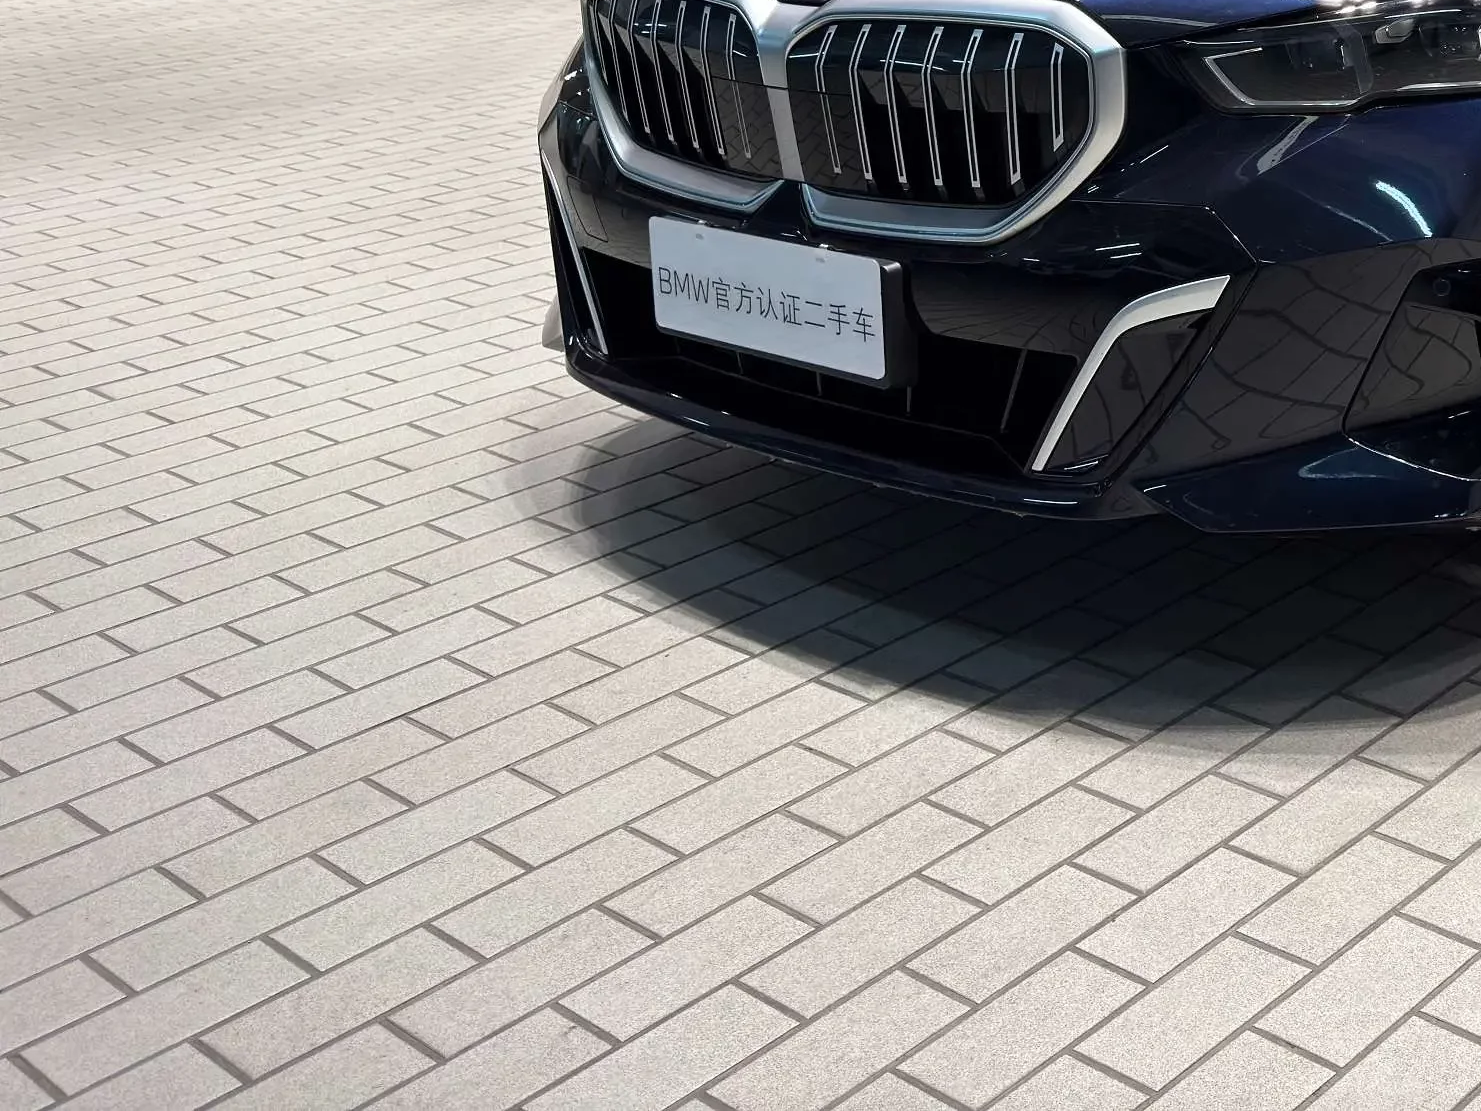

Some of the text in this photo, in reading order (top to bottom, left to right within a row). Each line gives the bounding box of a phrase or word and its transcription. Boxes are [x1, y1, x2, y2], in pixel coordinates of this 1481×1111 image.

[658, 266, 876, 343] BMW官方认证二手车
